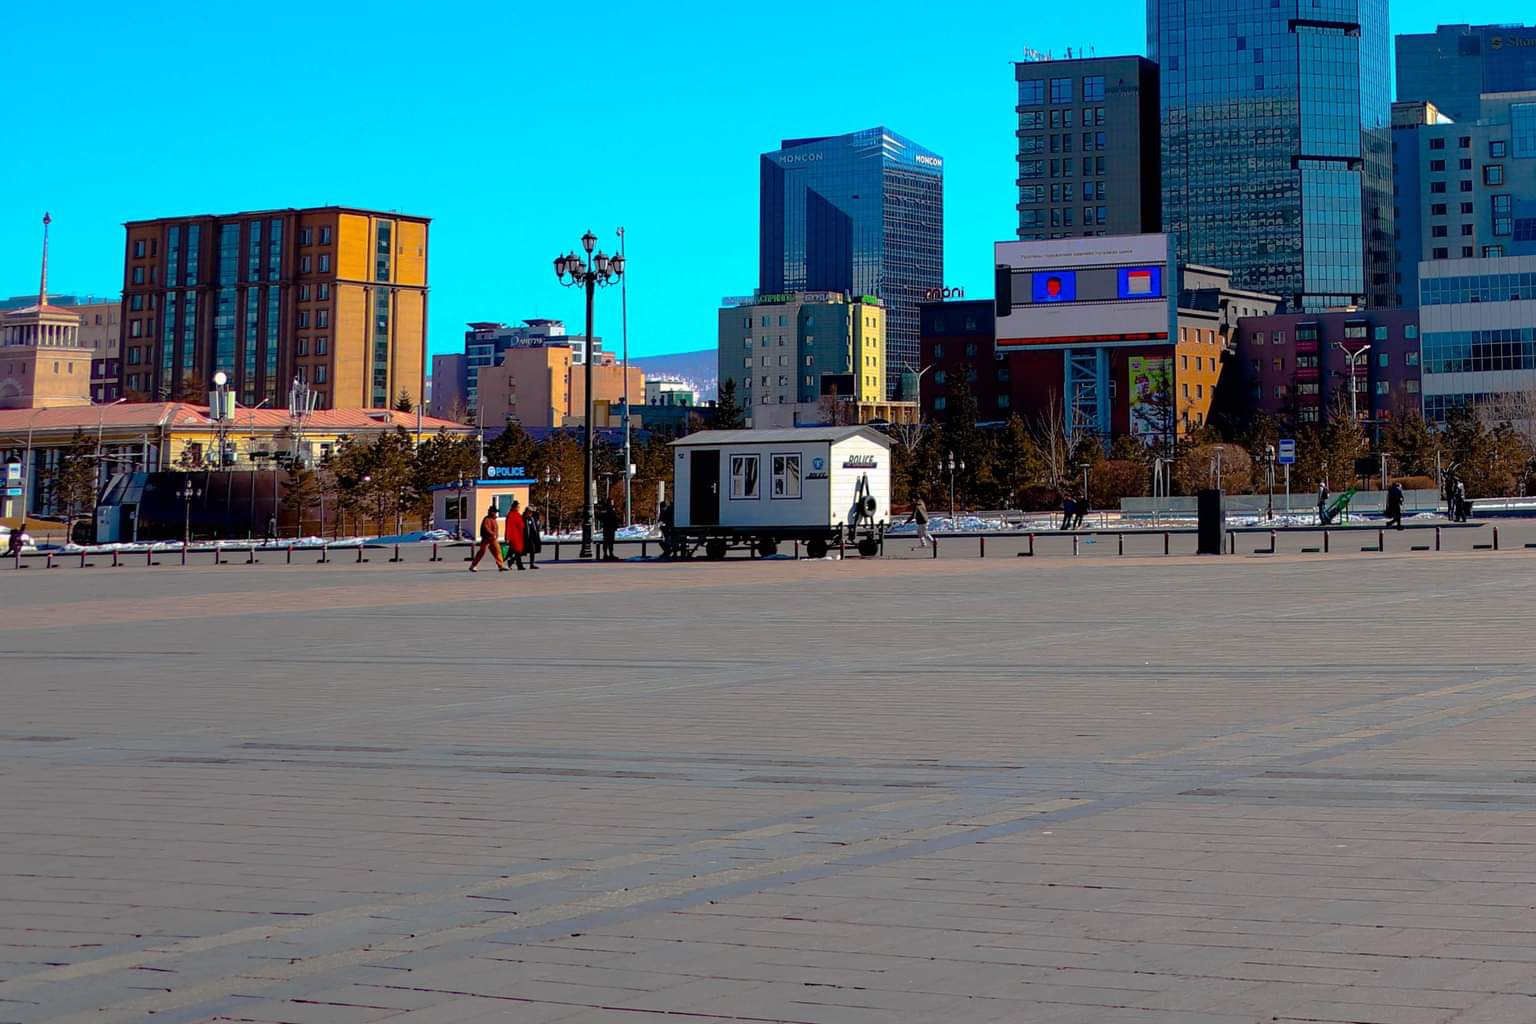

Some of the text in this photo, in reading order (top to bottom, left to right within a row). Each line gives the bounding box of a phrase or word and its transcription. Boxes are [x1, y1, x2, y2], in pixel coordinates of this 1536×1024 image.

[779, 152, 823, 163] MONCON
[916, 155, 942, 166] MONCON
[849, 455, 874, 465] POLICE
[495, 466, 525, 476] POLICE
